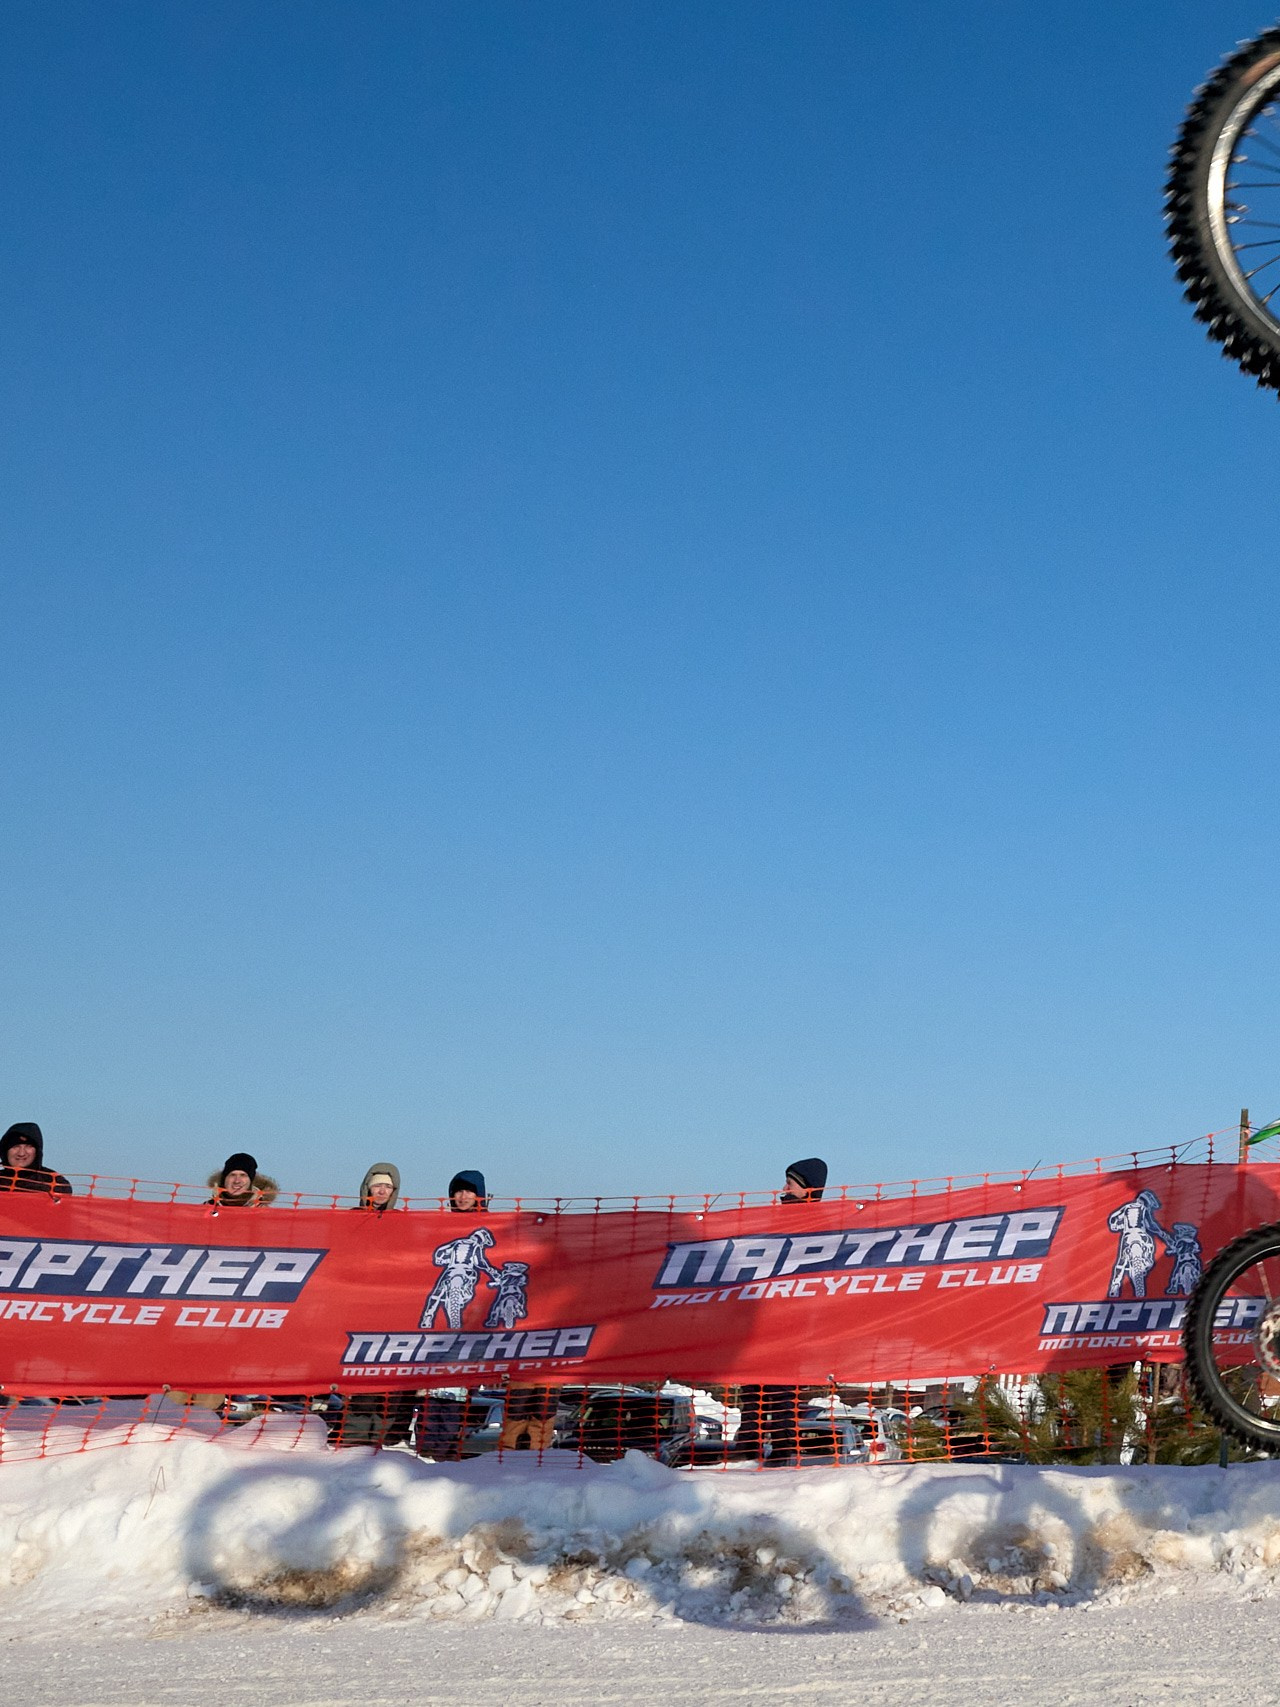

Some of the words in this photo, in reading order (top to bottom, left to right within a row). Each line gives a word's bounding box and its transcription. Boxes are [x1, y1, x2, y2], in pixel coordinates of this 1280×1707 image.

[0, 1241, 321, 1297] АРТНЕР
[649, 1272, 926, 1308] MOTORCYCLE
[937, 1264, 1043, 1288] CLUB
[0, 1300, 165, 1326] RCYCLE
[175, 1306, 289, 1329] CLUB
[342, 1363, 508, 1376] MOTORCYCLE
